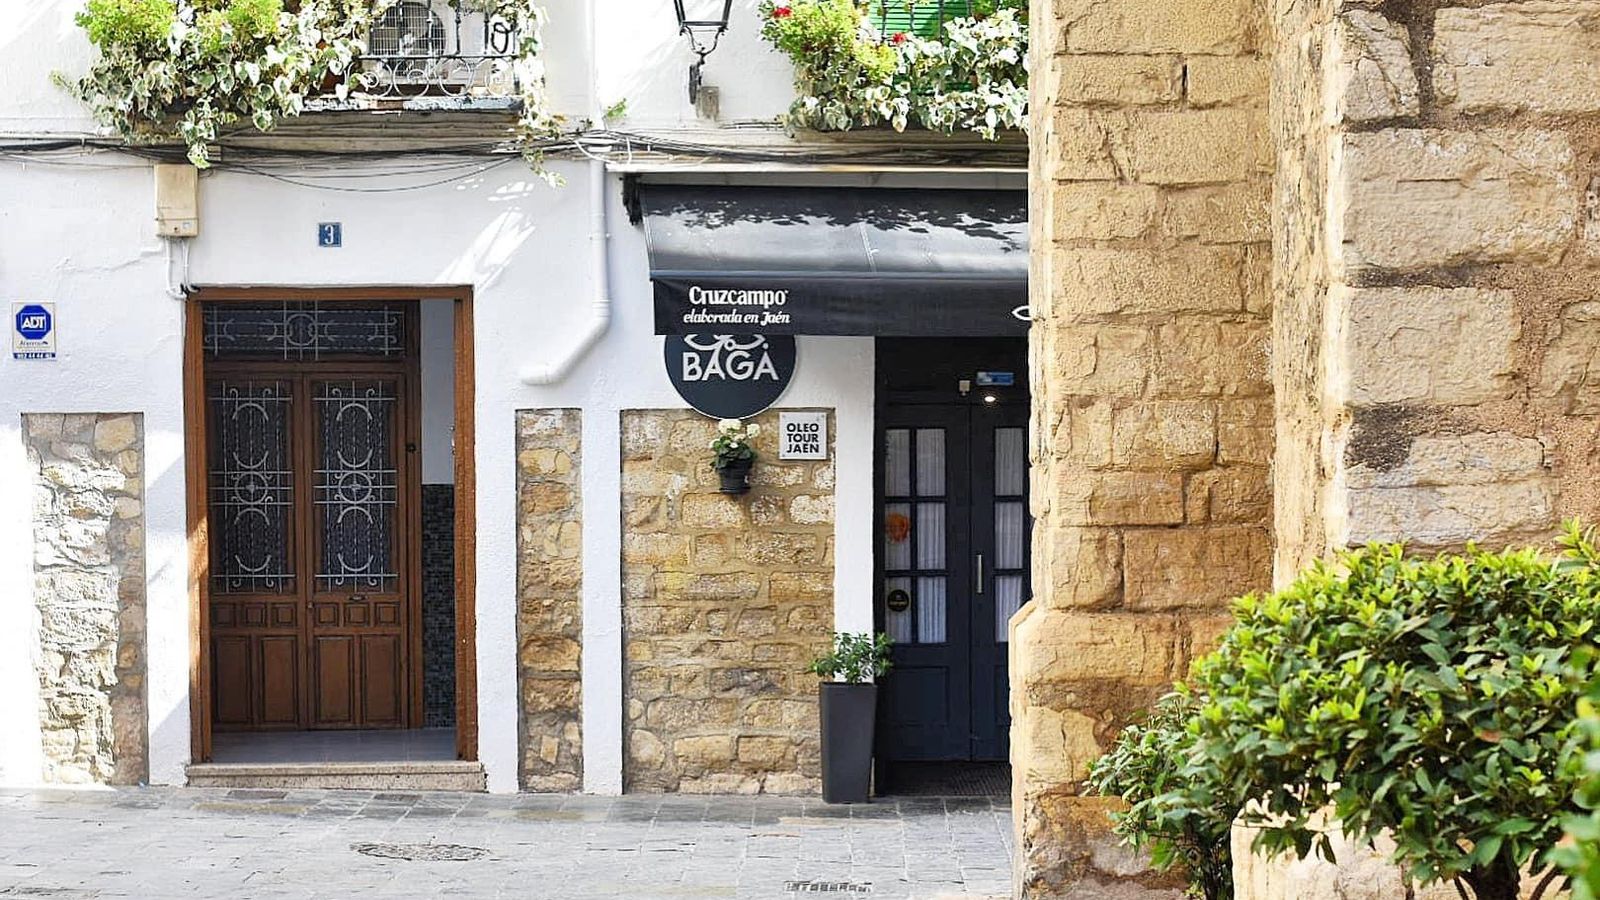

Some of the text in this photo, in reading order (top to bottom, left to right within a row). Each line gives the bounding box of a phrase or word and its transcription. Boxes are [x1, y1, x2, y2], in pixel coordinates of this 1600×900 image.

[324, 224, 334, 245] 3
[688, 286, 787, 309] Cruzcampo
[21, 316, 45, 329] ADT
[683, 308, 790, 326] elaborada en Jaén
[786, 422, 819, 432] OLEO
[786, 433, 819, 443] TOUR
[786, 443, 819, 453] JAEN
